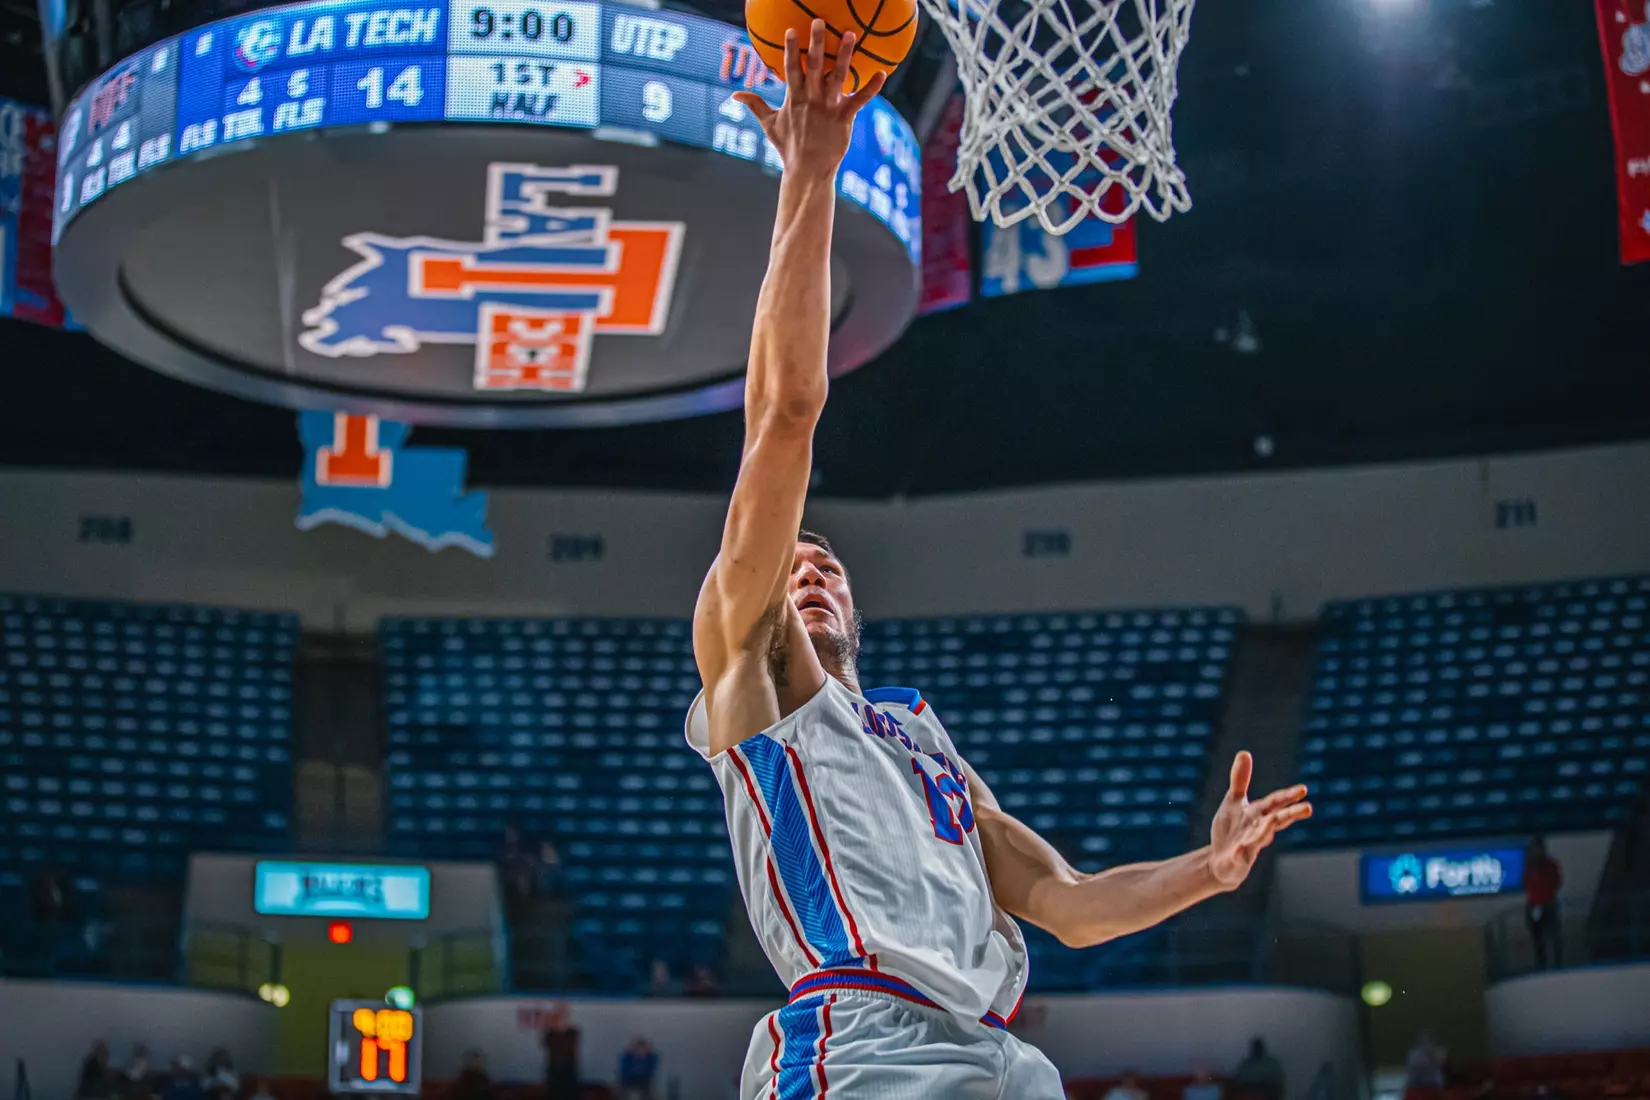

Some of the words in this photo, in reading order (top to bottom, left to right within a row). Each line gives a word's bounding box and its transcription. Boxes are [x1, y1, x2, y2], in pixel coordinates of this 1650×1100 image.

[286, 15, 335, 56] LA
[345, 8, 441, 47] TECH
[471, 7, 574, 42] 9:00
[610, 13, 689, 61] UTEP
[237, 77, 263, 105] 4
[357, 65, 424, 108] 14
[490, 63, 555, 86] 1ST
[643, 81, 672, 123] 9
